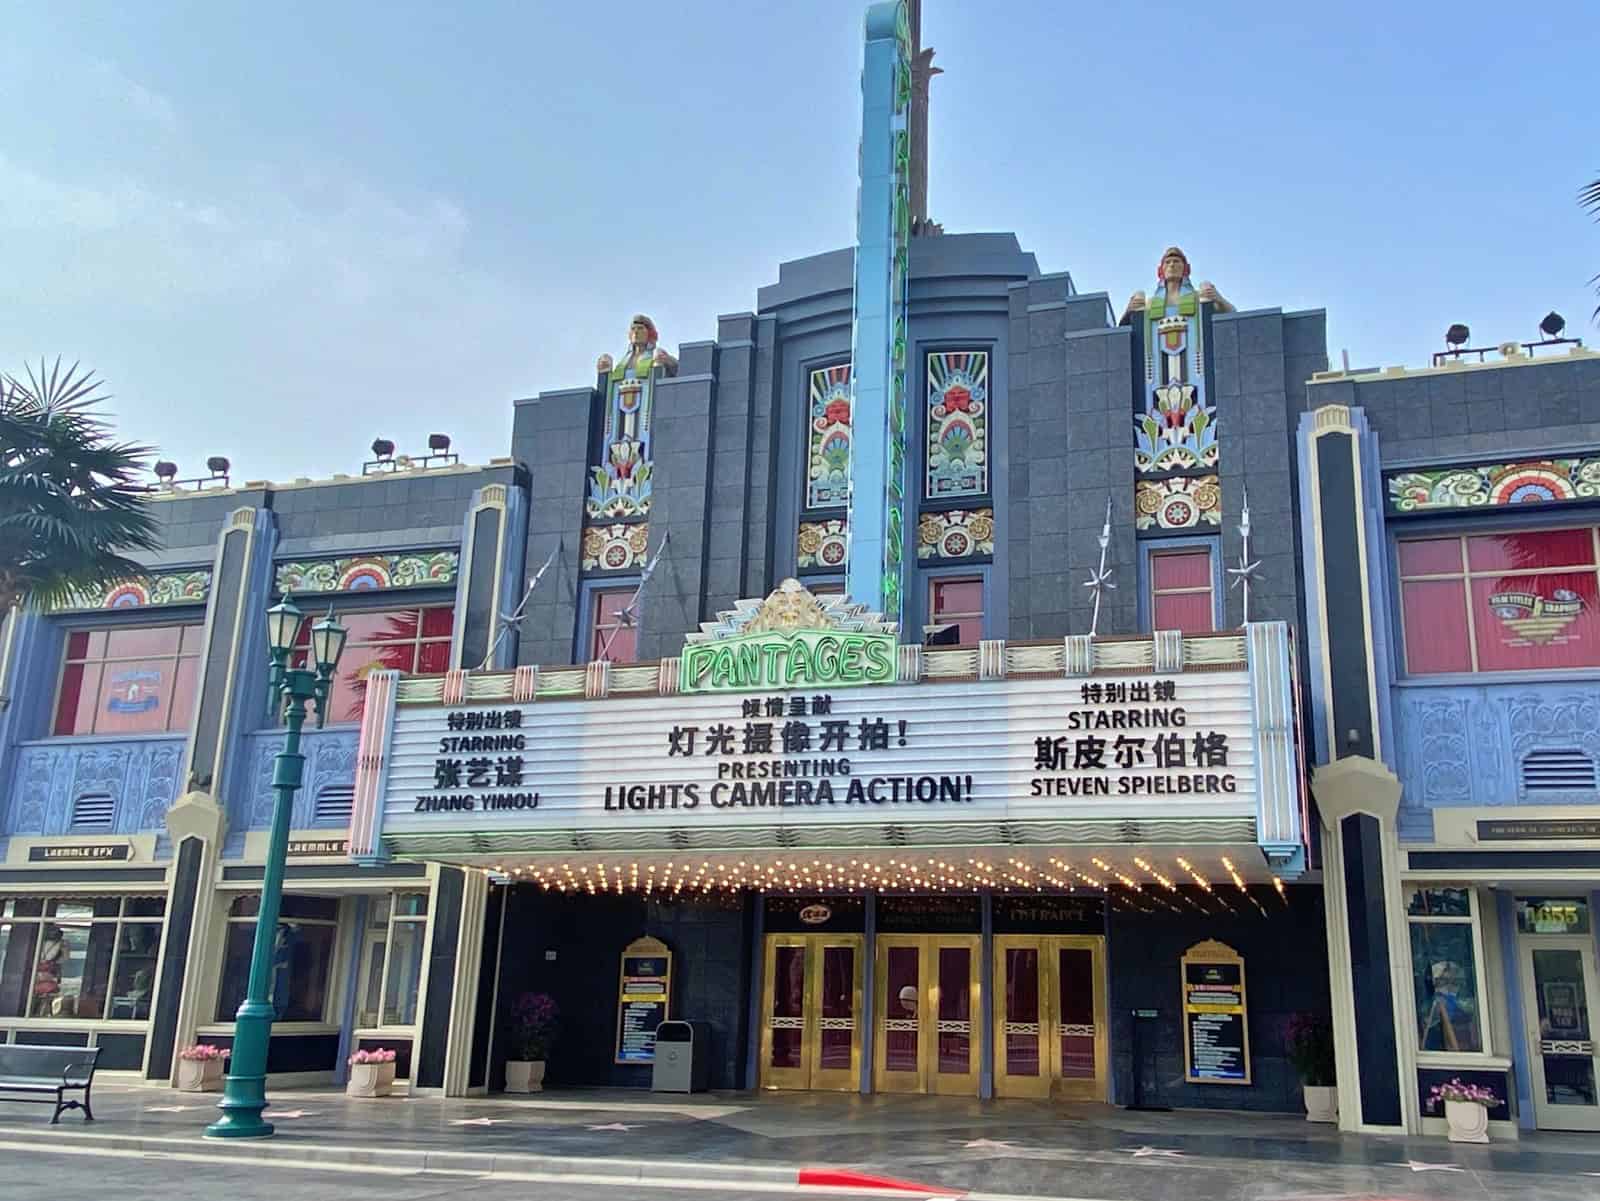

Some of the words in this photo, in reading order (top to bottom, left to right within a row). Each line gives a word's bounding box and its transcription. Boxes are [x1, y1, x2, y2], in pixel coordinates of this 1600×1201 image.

[689, 637, 891, 688] PANTAGES
[1081, 680, 1176, 704] 特别出镜
[742, 694, 832, 718] 倾情呈献
[448, 710, 522, 731] 特别出镜
[1068, 708, 1187, 730] STARRING
[440, 734, 526, 753] STARRING
[1034, 731, 1229, 771] 斯皮尔伯格
[434, 756, 525, 789] 张艺谋
[718, 758, 851, 779] PRESENTING
[605, 784, 700, 811] LIGHTS
[710, 780, 834, 807] CAMERA
[845, 775, 974, 804] ACTION!
[1030, 776, 1110, 797] STEVEN
[1117, 774, 1237, 795] SPIELBERG
[415, 794, 475, 813] ZHANG
[481, 793, 540, 810] YIMOU
